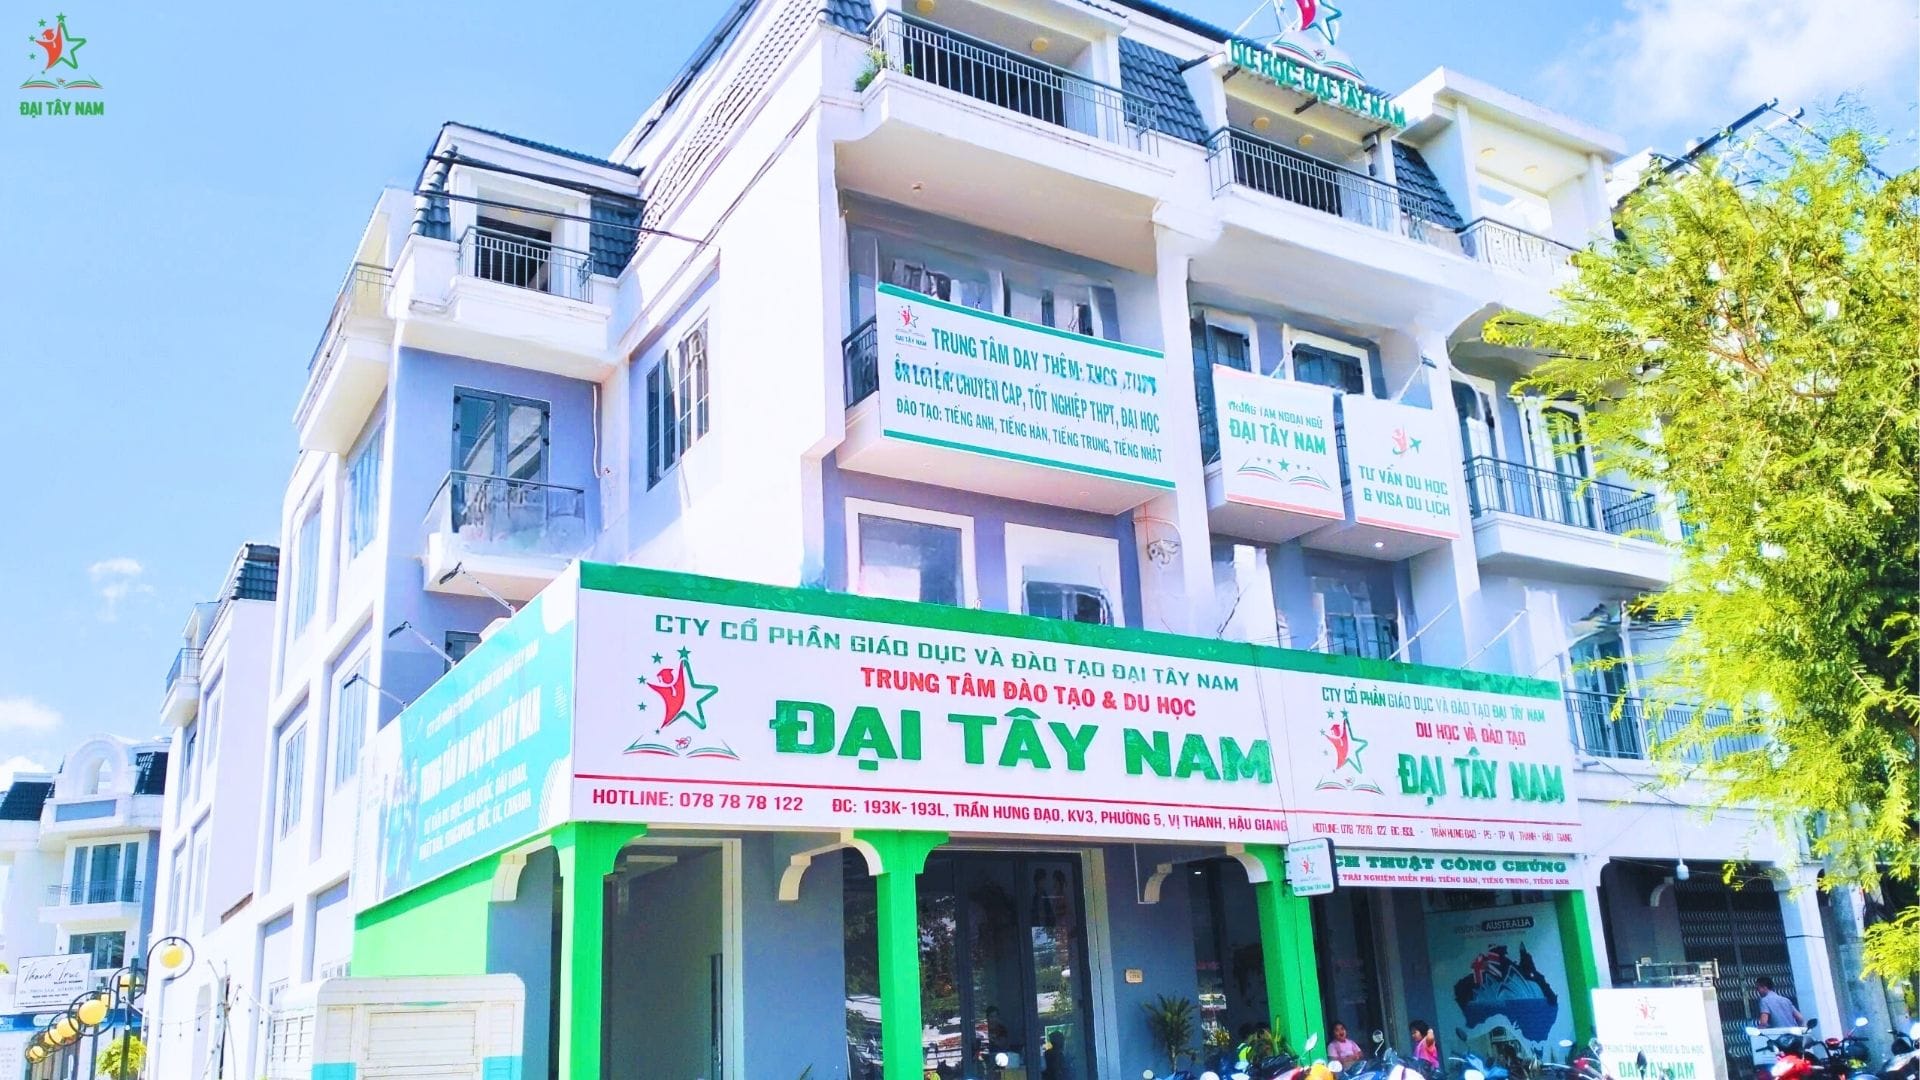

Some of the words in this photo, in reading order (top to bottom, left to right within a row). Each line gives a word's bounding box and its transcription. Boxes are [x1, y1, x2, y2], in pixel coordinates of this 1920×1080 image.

[932, 327, 977, 358] TRUNG
[979, 336, 1010, 366] TÂM
[896, 395, 917, 416] ĐÀO
[1050, 392, 1088, 423] NGHIỆP
[1140, 410, 1160, 437] HỌC
[1229, 417, 1257, 444] ĐẠI
[1260, 422, 1289, 448] TÂY
[1293, 431, 1327, 456] NAM
[1376, 489, 1403, 508] VISA
[1406, 495, 1423, 511] DU
[1405, 475, 1422, 490] DU
[1425, 478, 1449, 498] HỌC
[655, 613, 711, 636] CTY
[721, 617, 759, 643] CỔ
[769, 624, 841, 651] PHẦN
[851, 635, 909, 658] GIÁO
[918, 641, 966, 665] DỤC
[975, 646, 1005, 667] VÀ
[1012, 647, 1057, 674] ĐÀO
[1064, 658, 1105, 680] TẠO
[1112, 662, 1146, 686] ĐẠI
[1153, 665, 1190, 688] TÂY
[1197, 673, 1240, 692] NAM
[860, 666, 940, 694] TRUNG
[946, 672, 996, 699] TÂM
[1003, 676, 1048, 705] ĐÀO
[1053, 685, 1096, 711] TẠO
[1102, 690, 1118, 710] &
[1123, 693, 1151, 712] DU
[1156, 696, 1197, 720] HỌC
[1321, 687, 1341, 703] CTY
[1387, 691, 1411, 709] GIÁO
[1413, 696, 1434, 714] DỤC
[769, 699, 922, 771] ĐẠI
[947, 706, 1099, 771] TÂY
[1123, 726, 1274, 785] NAM
[1416, 722, 1433, 738] DU
[1436, 724, 1460, 745] HỌC
[1463, 721, 1478, 742] VÀ
[1481, 722, 1503, 744] ĐÀO
[1506, 730, 1527, 750] TẠO
[1398, 753, 1447, 806] ĐẠI
[1453, 746, 1498, 799] TÂY
[1508, 761, 1566, 804] NAM
[593, 789, 674, 807] HOTLINE:
[679, 792, 714, 809] 078
[719, 794, 741, 810] 78
[746, 795, 768, 810] 78
[774, 796, 804, 812] 122
[832, 798, 857, 814] ĐC:
[953, 801, 989, 818] TRẦN
[992, 804, 1031, 821] HƯNG
[1033, 807, 1063, 825] ĐẠO,
[1067, 808, 1098, 825] KV3,
[1100, 808, 1151, 826] PHƯỜNG
[1153, 813, 1165, 828] 5,
[1167, 813, 1181, 830] VỊ
[1183, 815, 1226, 831] THANH,
[1228, 814, 1252, 832] HẬU
[1254, 817, 1289, 832] GIANG
[1366, 855, 1435, 871] THUẬT
[1440, 856, 1497, 872] CÔNG
[1502, 859, 1567, 873] CHỨNG
[1486, 919, 1531, 930] AUSTRALIA
